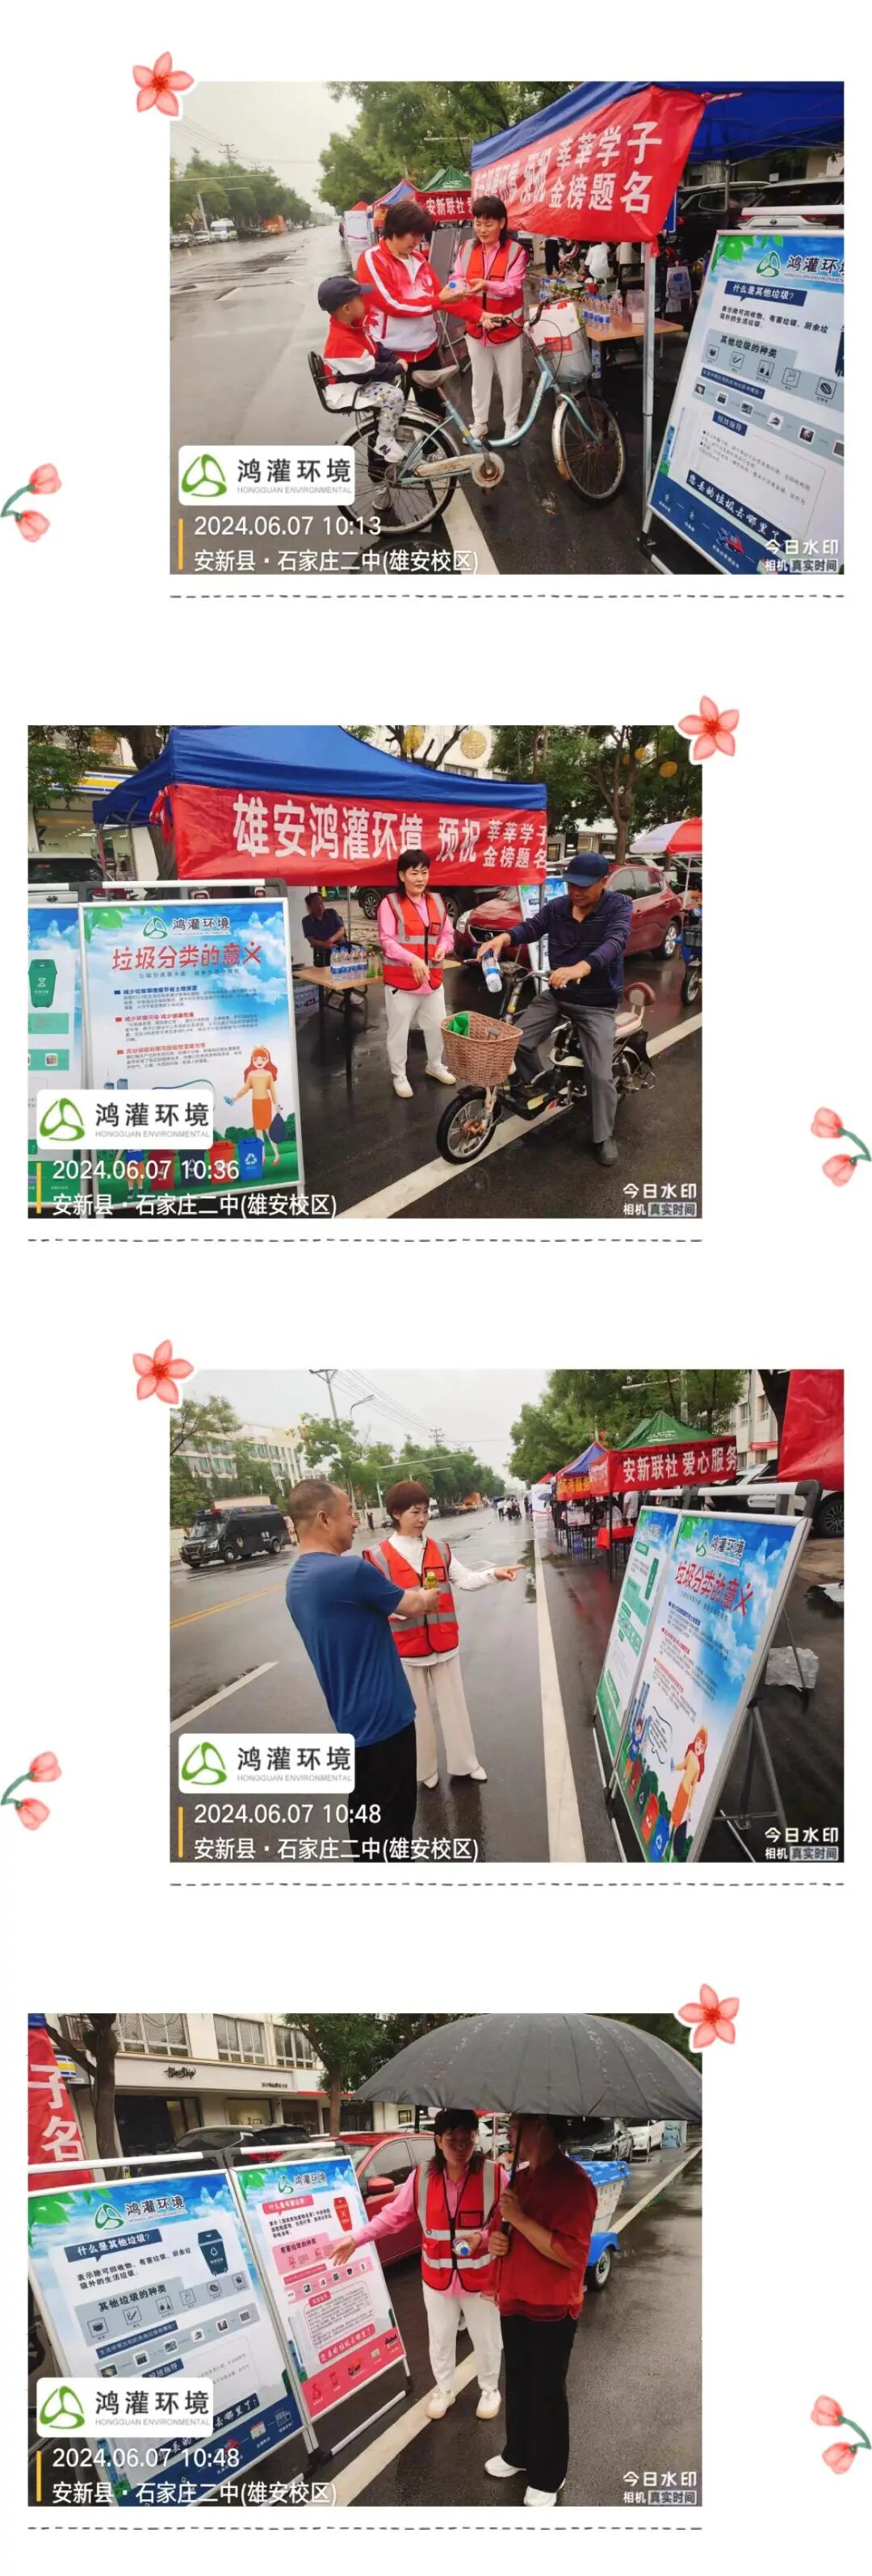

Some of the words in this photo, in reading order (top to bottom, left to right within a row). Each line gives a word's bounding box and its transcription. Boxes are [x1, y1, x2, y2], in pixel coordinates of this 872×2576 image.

[556, 122, 662, 170] 莘莘学子
[426, 197, 466, 216] 安新联社
[549, 171, 653, 214] 金榜题名
[720, 335, 778, 359] 其他垃圾的种类
[233, 793, 424, 861] 雄安鸿灌环境
[436, 817, 480, 863] 预祝
[488, 820, 547, 844] 莘莘学子
[483, 845, 547, 870] 金榜题名
[173, 917, 230, 931] 鸿灌环境
[112, 941, 262, 971] 垃圾分类的意义
[623, 1454, 678, 1483] 安新联社
[682, 1445, 738, 1477] 爱心服务
[675, 1560, 753, 1616] 垃圾分类的意义
[28, 2064, 66, 2109] 子
[40, 2116, 85, 2162] 名
[125, 2196, 186, 2216] 鸿灌环境
[78, 2234, 150, 2256] 什么是其他垃圾?
[99, 2284, 167, 2312] 其他垃圾的种类
